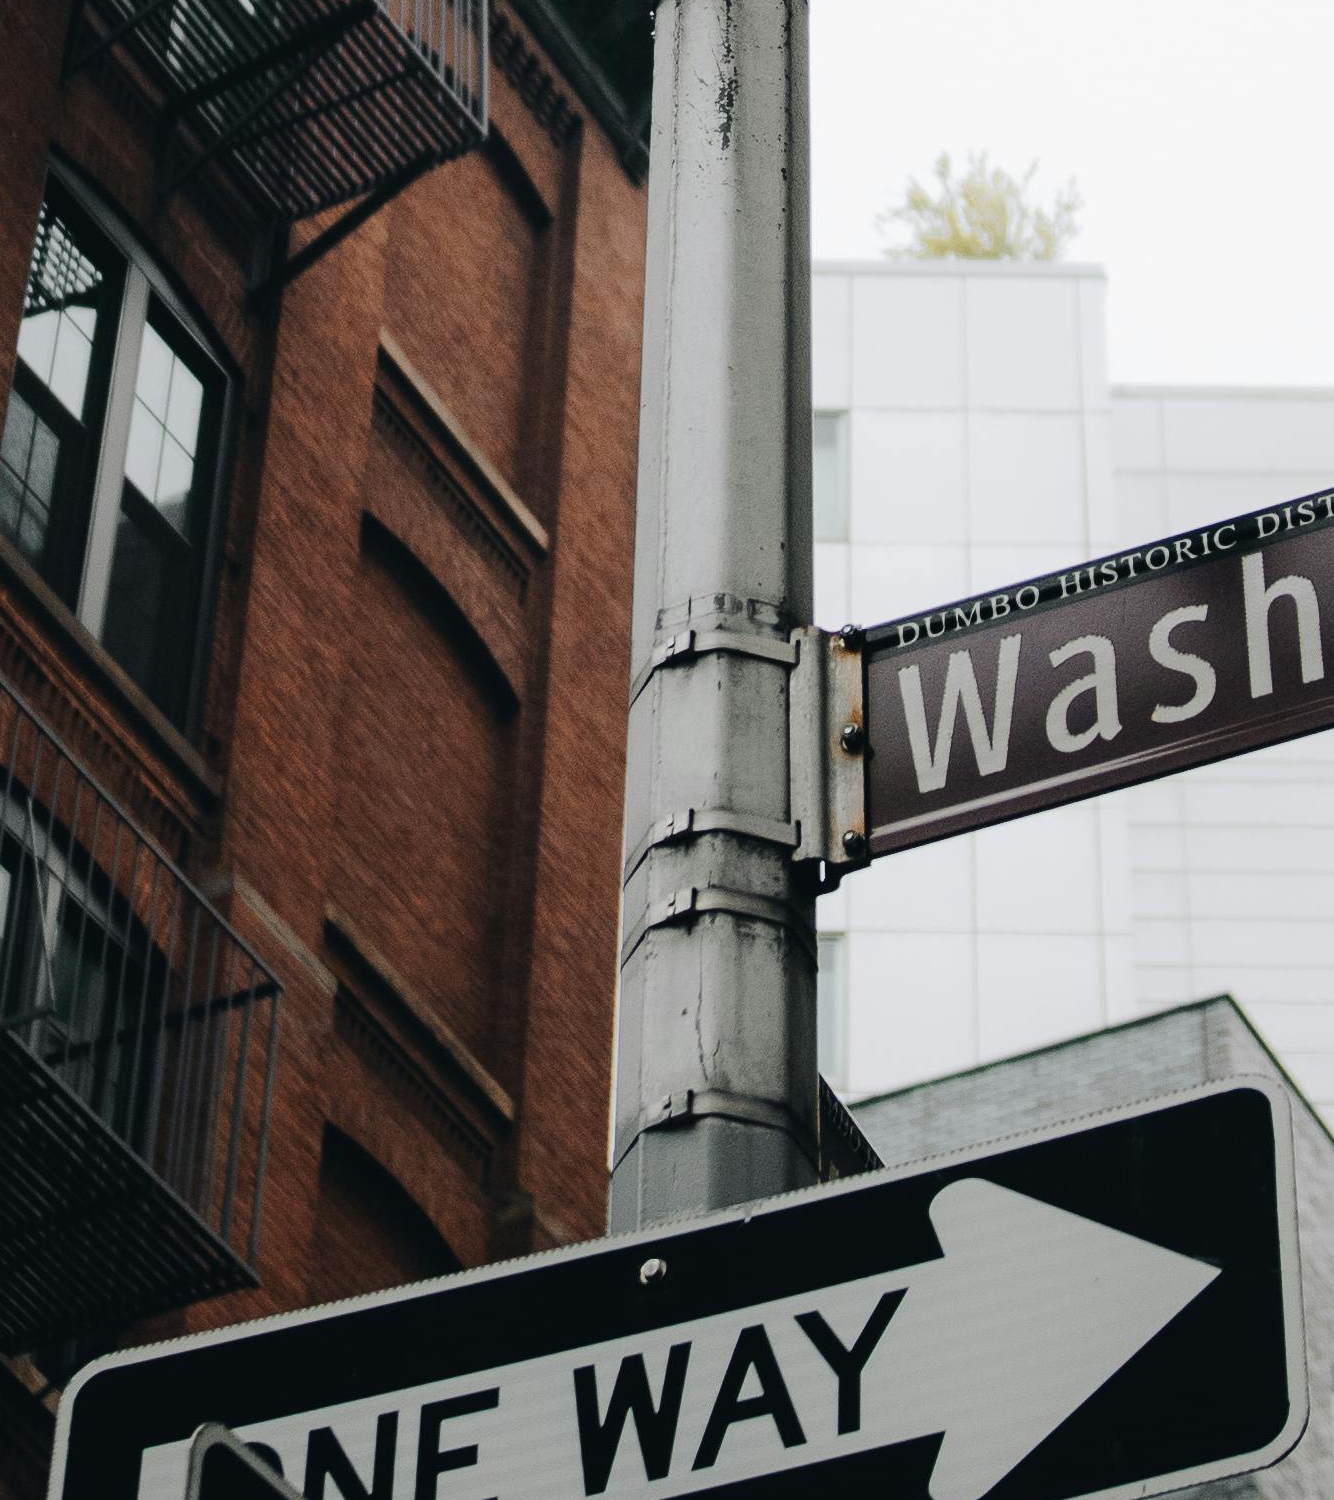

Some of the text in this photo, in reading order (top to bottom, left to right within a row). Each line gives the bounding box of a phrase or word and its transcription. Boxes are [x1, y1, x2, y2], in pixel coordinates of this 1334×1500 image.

[896, 584, 1041, 649] DUMBO
[1059, 523, 1241, 599] HISTORIC
[572, 1287, 909, 1498] WAY
